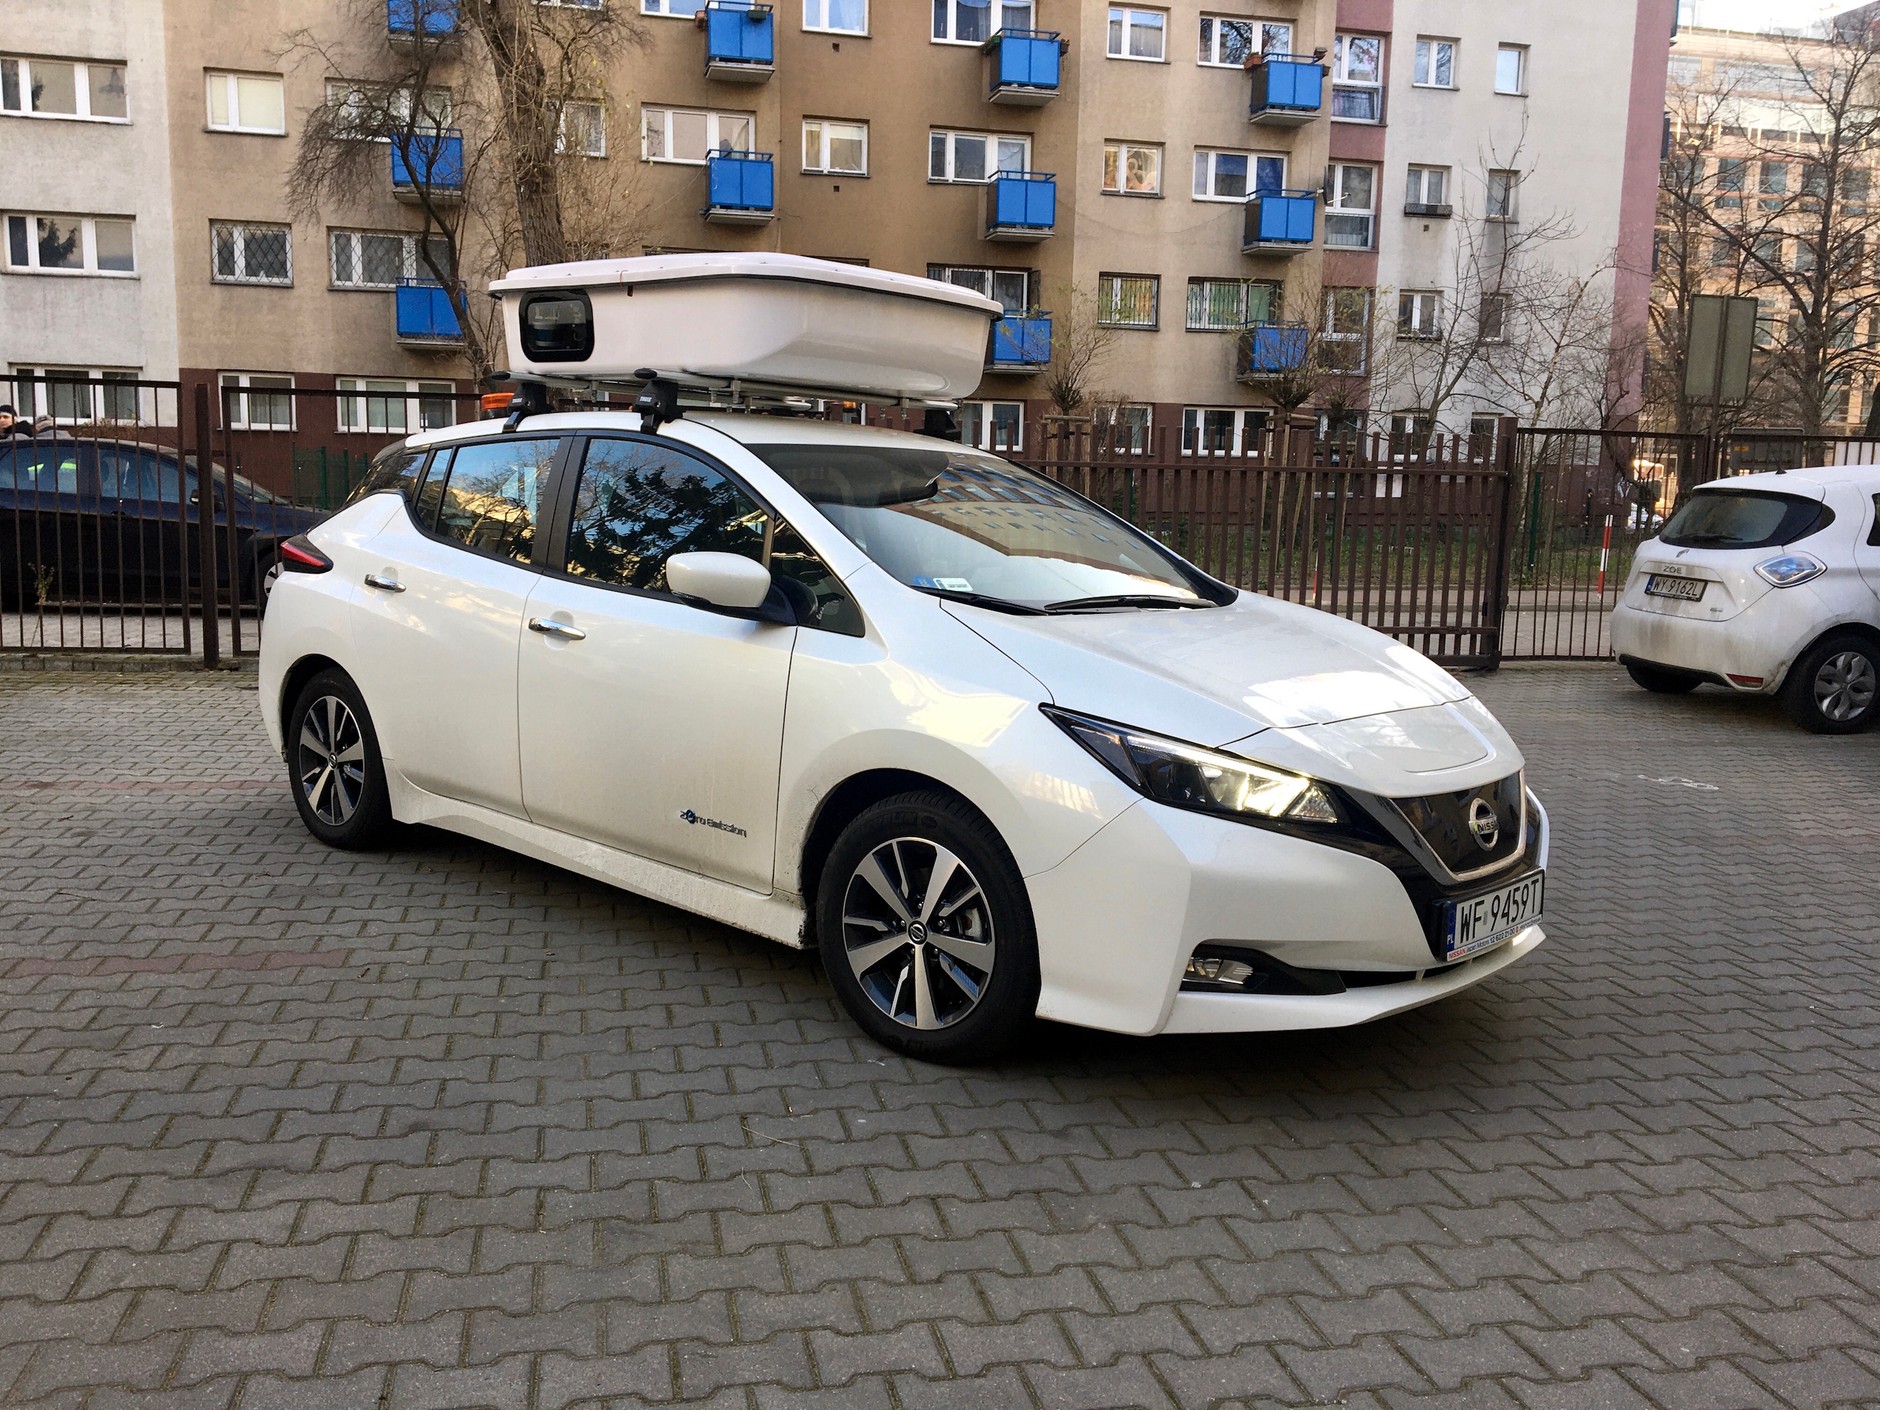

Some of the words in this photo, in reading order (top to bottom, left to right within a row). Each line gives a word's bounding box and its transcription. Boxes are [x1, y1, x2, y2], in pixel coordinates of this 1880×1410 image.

[1663, 566, 1682, 574] ZOE
[1653, 578, 1668, 591] WY
[1668, 579, 1698, 596] 9162L
[1460, 899, 1485, 943] WF
[1490, 877, 1540, 932] 9459T
[1447, 934, 1454, 945] PL
[1449, 948, 1467, 960] NISSAN
